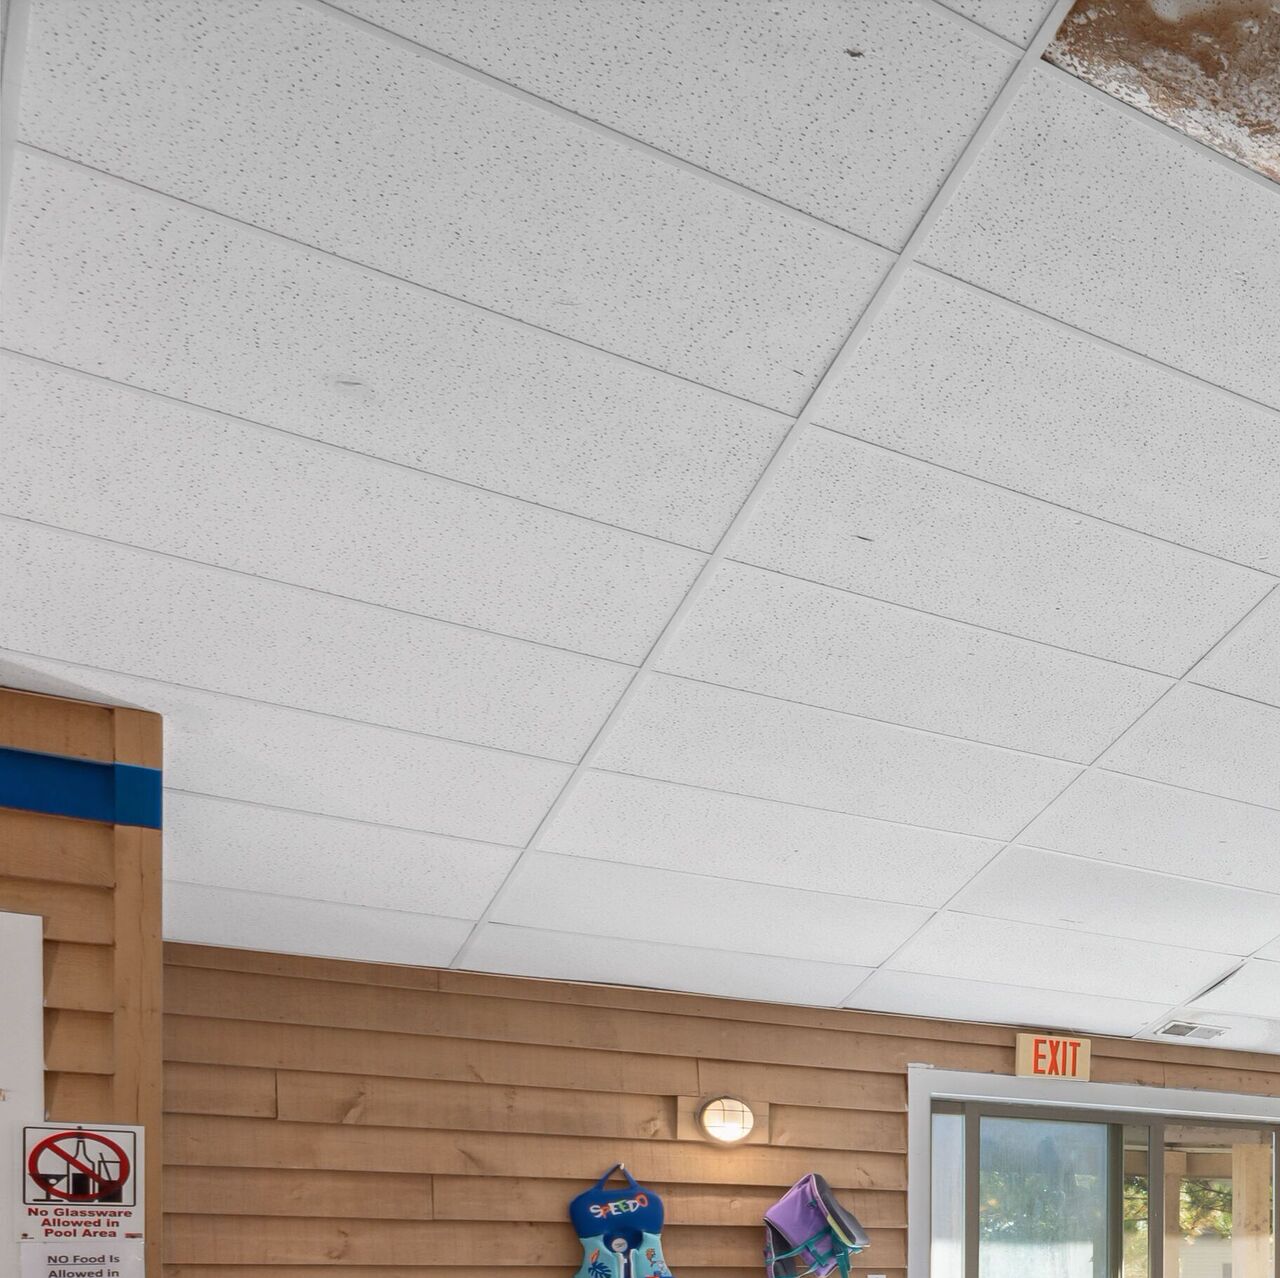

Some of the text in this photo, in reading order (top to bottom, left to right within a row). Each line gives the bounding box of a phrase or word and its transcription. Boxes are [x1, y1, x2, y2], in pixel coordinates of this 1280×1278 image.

[1033, 1038, 1081, 1077] EXIT
[589, 1191, 649, 1219] SPEEDO
[27, 1207, 133, 1218] No Glassware
[41, 1218, 120, 1227] Allowed in
[44, 1228, 77, 1237] Pool
[82, 1229, 117, 1238] Area
[47, 1255, 120, 1264] NO Food Is
[48, 1268, 119, 1278] Allowed in
